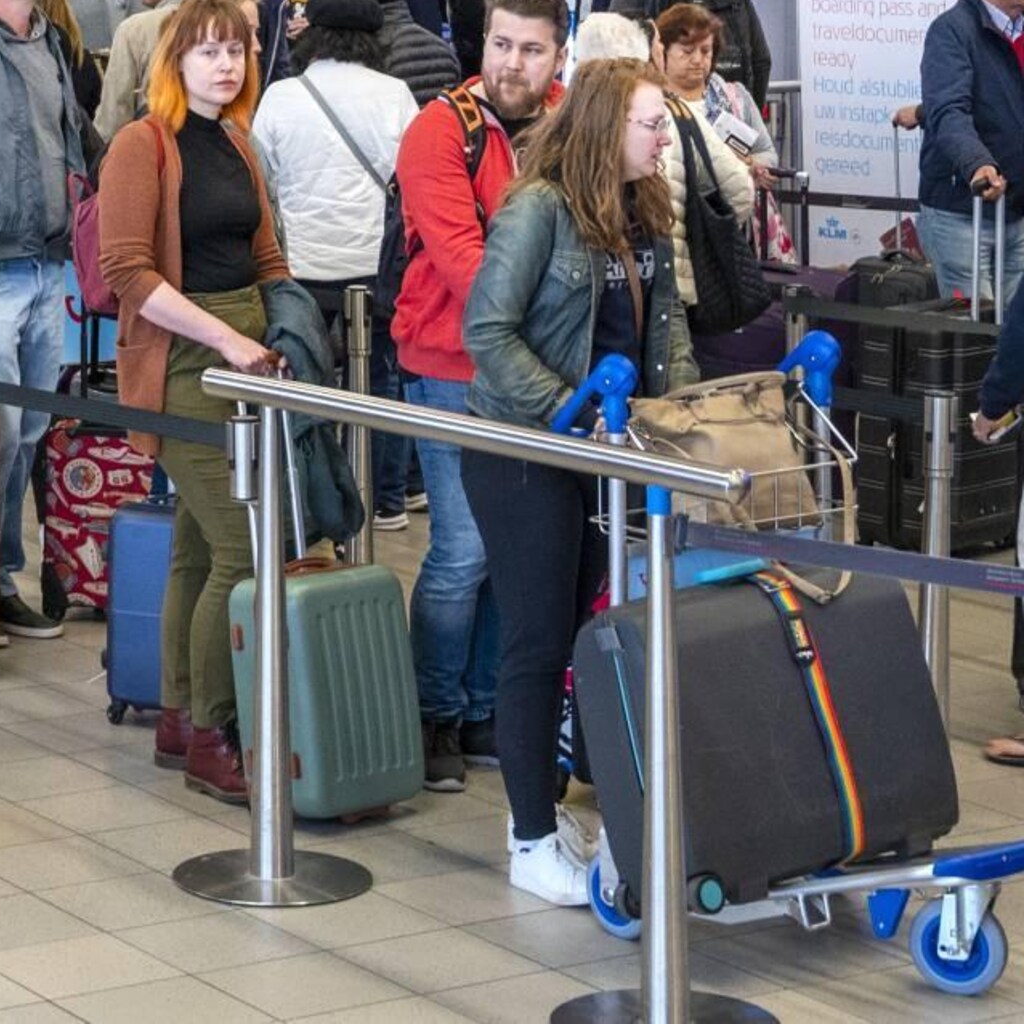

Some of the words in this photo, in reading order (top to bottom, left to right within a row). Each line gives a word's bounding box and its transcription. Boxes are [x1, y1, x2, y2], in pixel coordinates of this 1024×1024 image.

[813, 50, 857, 70] ready
[813, 77, 854, 95] Houd
[814, 104, 835, 119] uw
[815, 157, 870, 177] gereed
[818, 226, 848, 240] KLM
